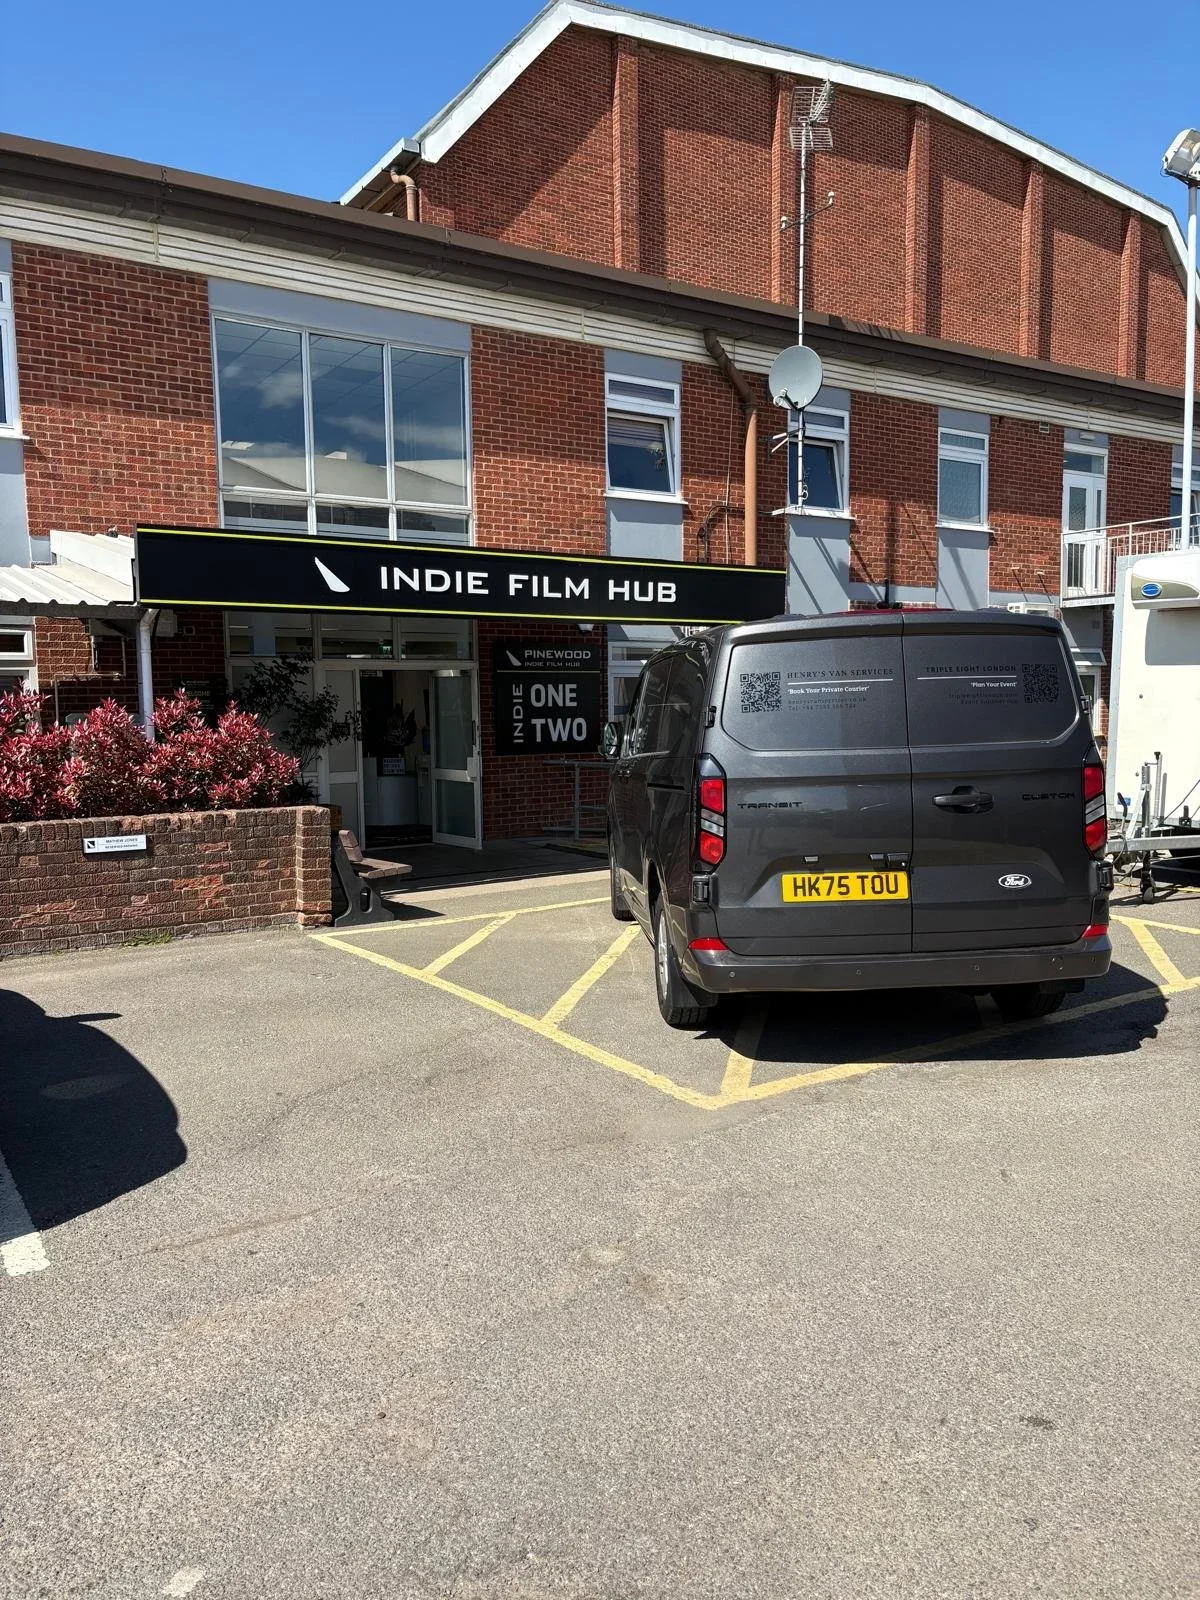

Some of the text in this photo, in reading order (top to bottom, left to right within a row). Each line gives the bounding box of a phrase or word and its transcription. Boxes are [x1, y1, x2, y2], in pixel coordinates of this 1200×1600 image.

[380, 566, 677, 603] INDIE FILM HUB
[524, 650, 592, 659] PINEWOOD
[787, 668, 894, 679] HENRY'S VAN SERVICES
[530, 683, 577, 707] ONE
[512, 683, 524, 743] INDIE
[531, 717, 587, 743] TWO
[737, 801, 803, 809] TRANSIT
[1022, 792, 1075, 801] CUSTOM
[792, 873, 899, 898] HK75 TOU
[1004, 875, 1026, 887] Ford
